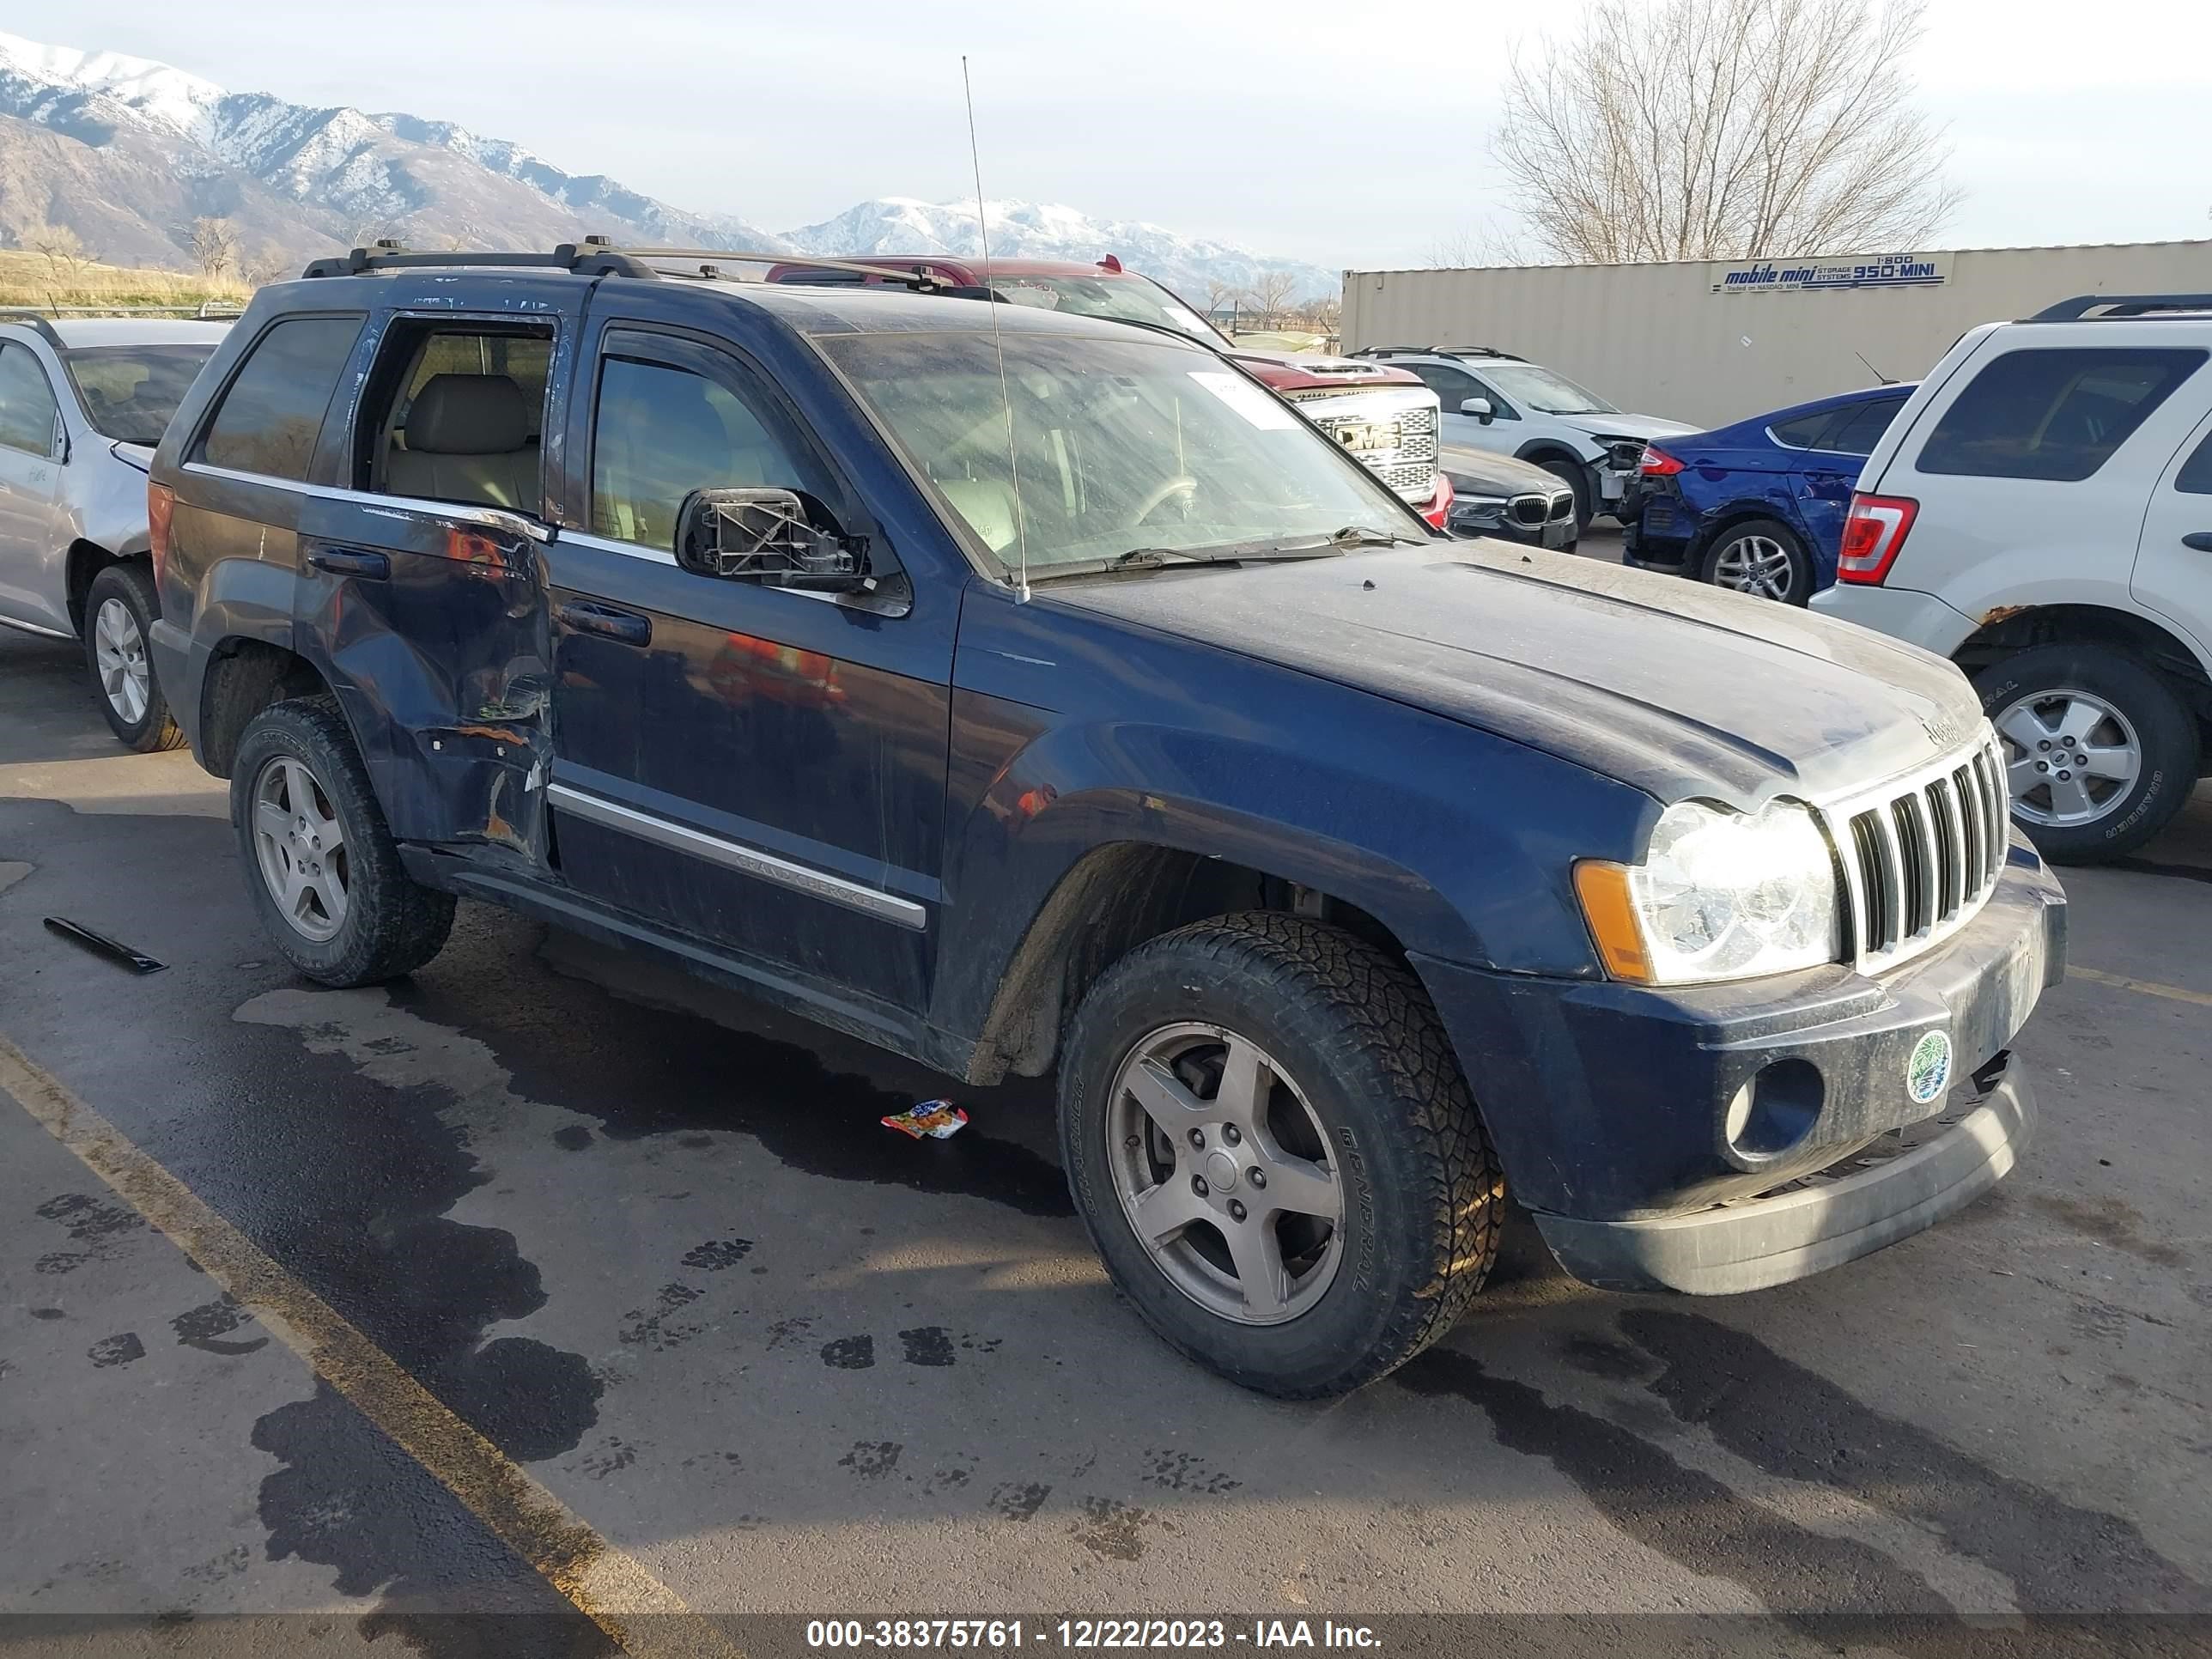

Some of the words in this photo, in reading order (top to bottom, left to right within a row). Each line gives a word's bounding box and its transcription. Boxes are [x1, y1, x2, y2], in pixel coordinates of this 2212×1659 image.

[1724, 263, 1778, 284] mobile
[1779, 265, 1818, 283] mini
[1853, 263, 1935, 278] 950-MINI
[736, 855, 791, 881] GRAND
[795, 874, 880, 908] CHEROKEE
[1071, 1075, 1097, 1217] GRABBER
[1338, 1127, 1374, 1291] GENERAL
